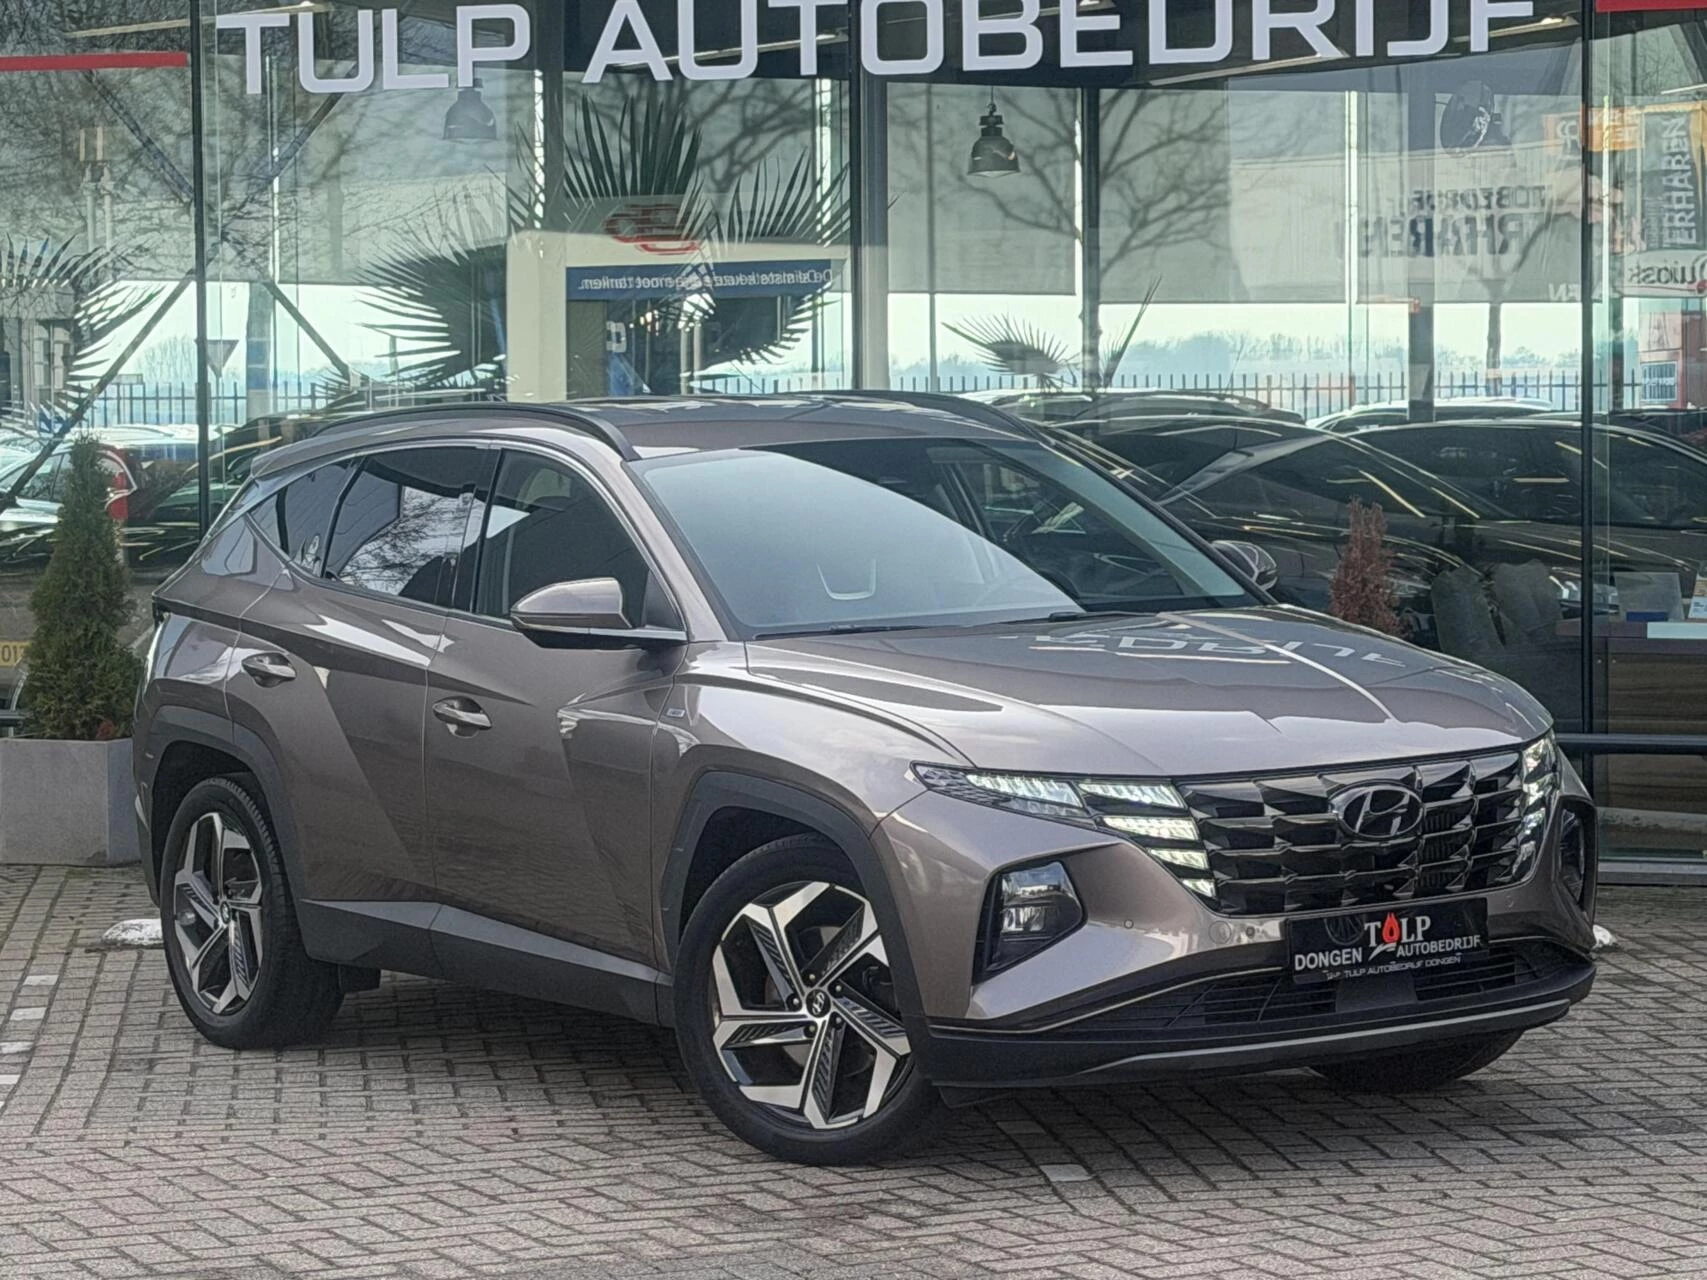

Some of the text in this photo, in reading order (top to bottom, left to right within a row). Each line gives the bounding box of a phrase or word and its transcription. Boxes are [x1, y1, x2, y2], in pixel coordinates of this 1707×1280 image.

[216, 0, 1534, 95] TULP AUTOBEDRIJF
[1294, 935, 1481, 971] DONGEN AUTOBEDRIJF
